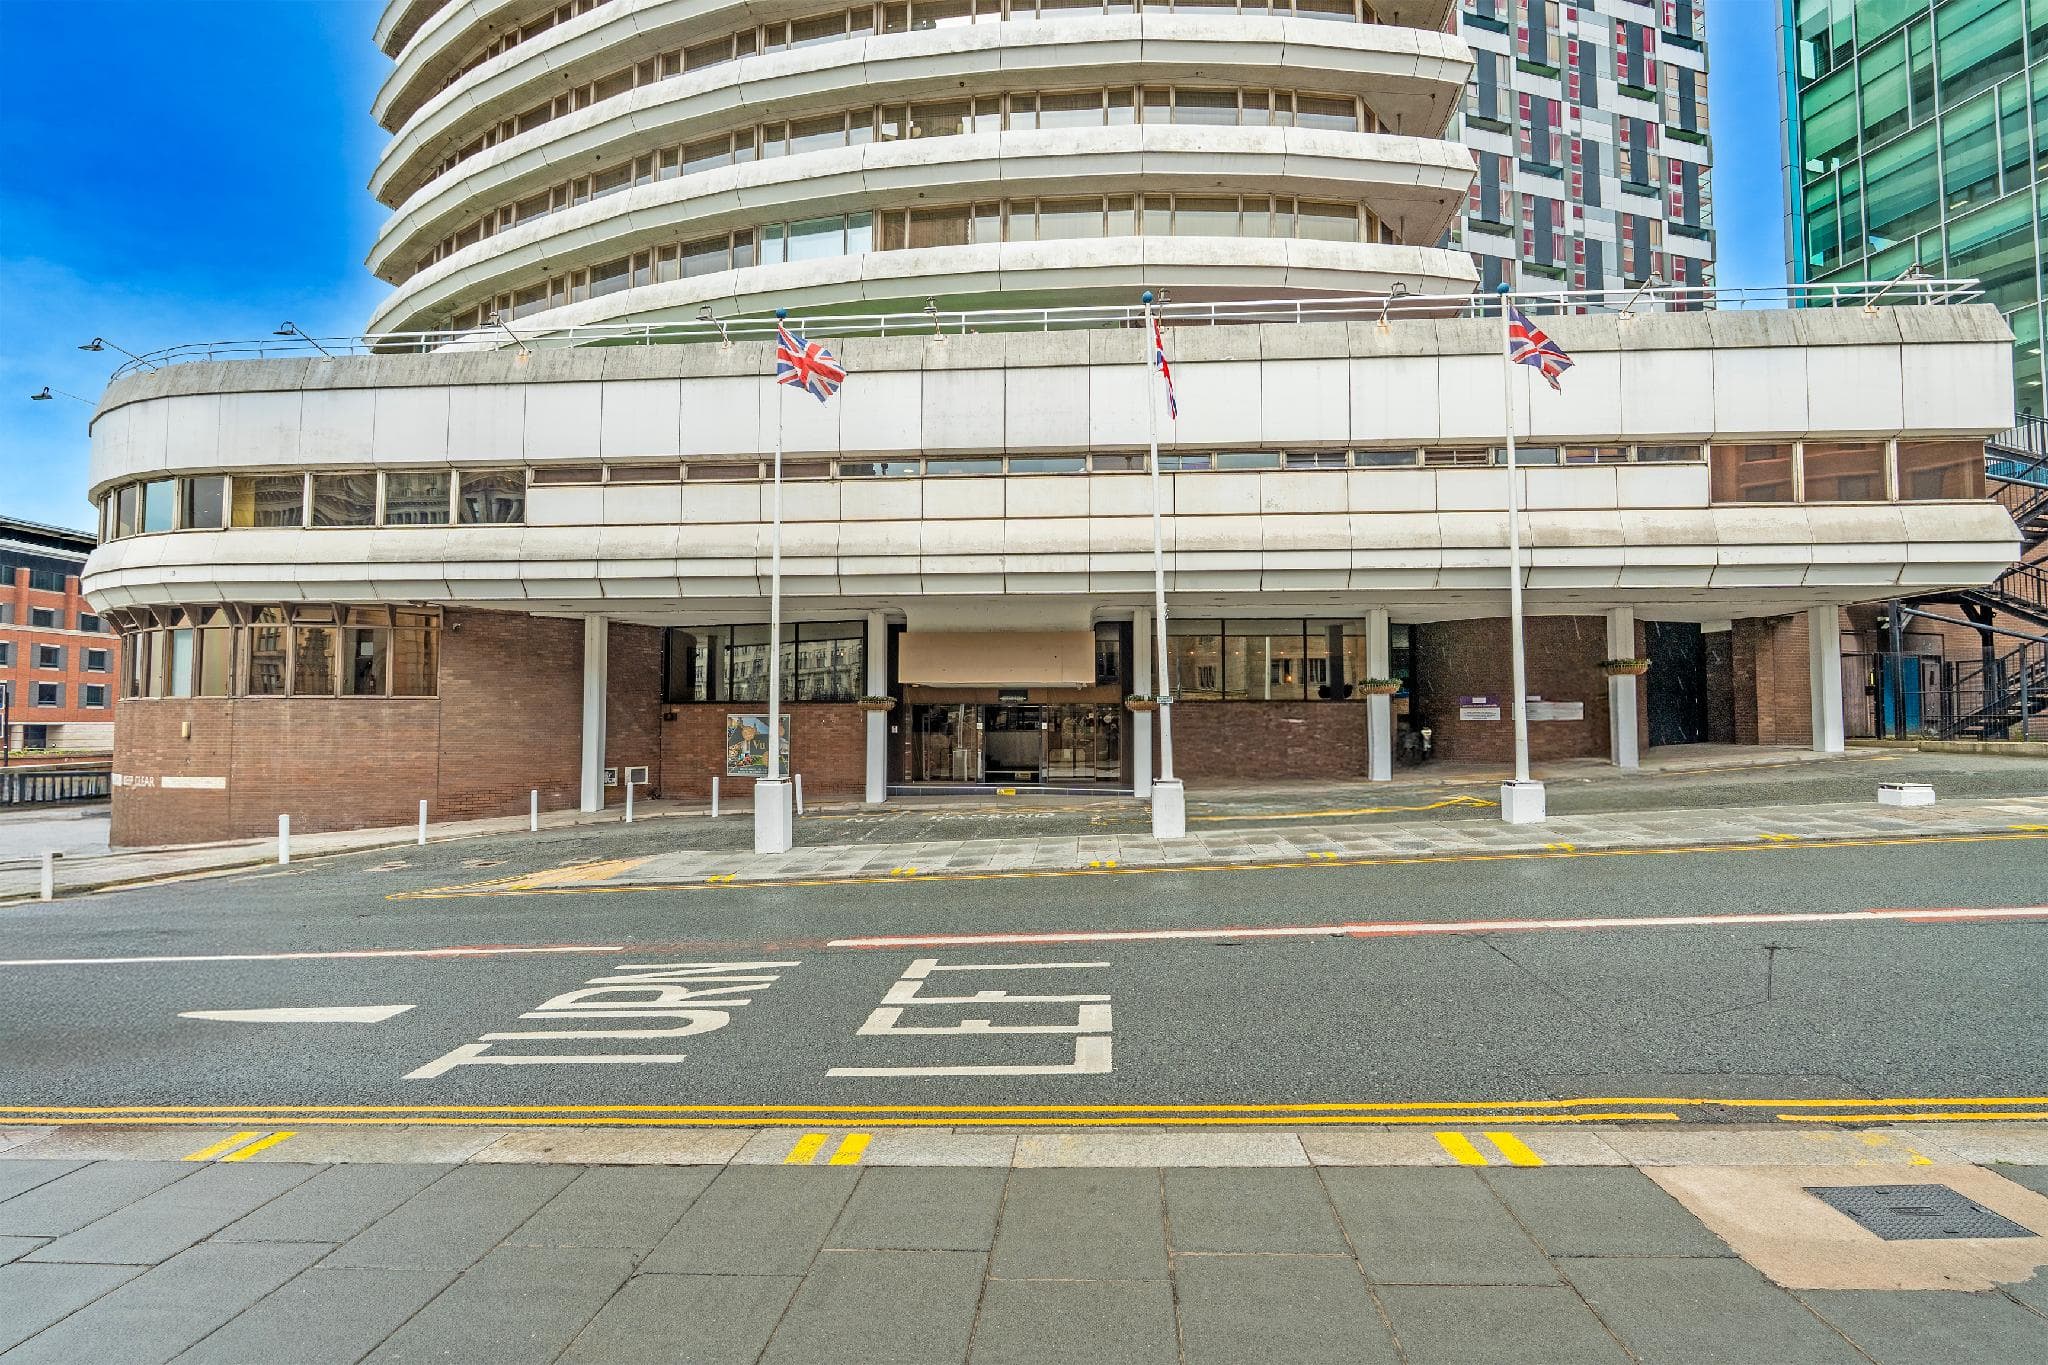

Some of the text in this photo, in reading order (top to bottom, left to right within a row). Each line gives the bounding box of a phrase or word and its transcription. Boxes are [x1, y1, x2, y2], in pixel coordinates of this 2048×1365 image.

[135, 776, 155, 787] CLEAR
[401, 961, 802, 1080] TURN
[826, 958, 1112, 1077] LEFT
